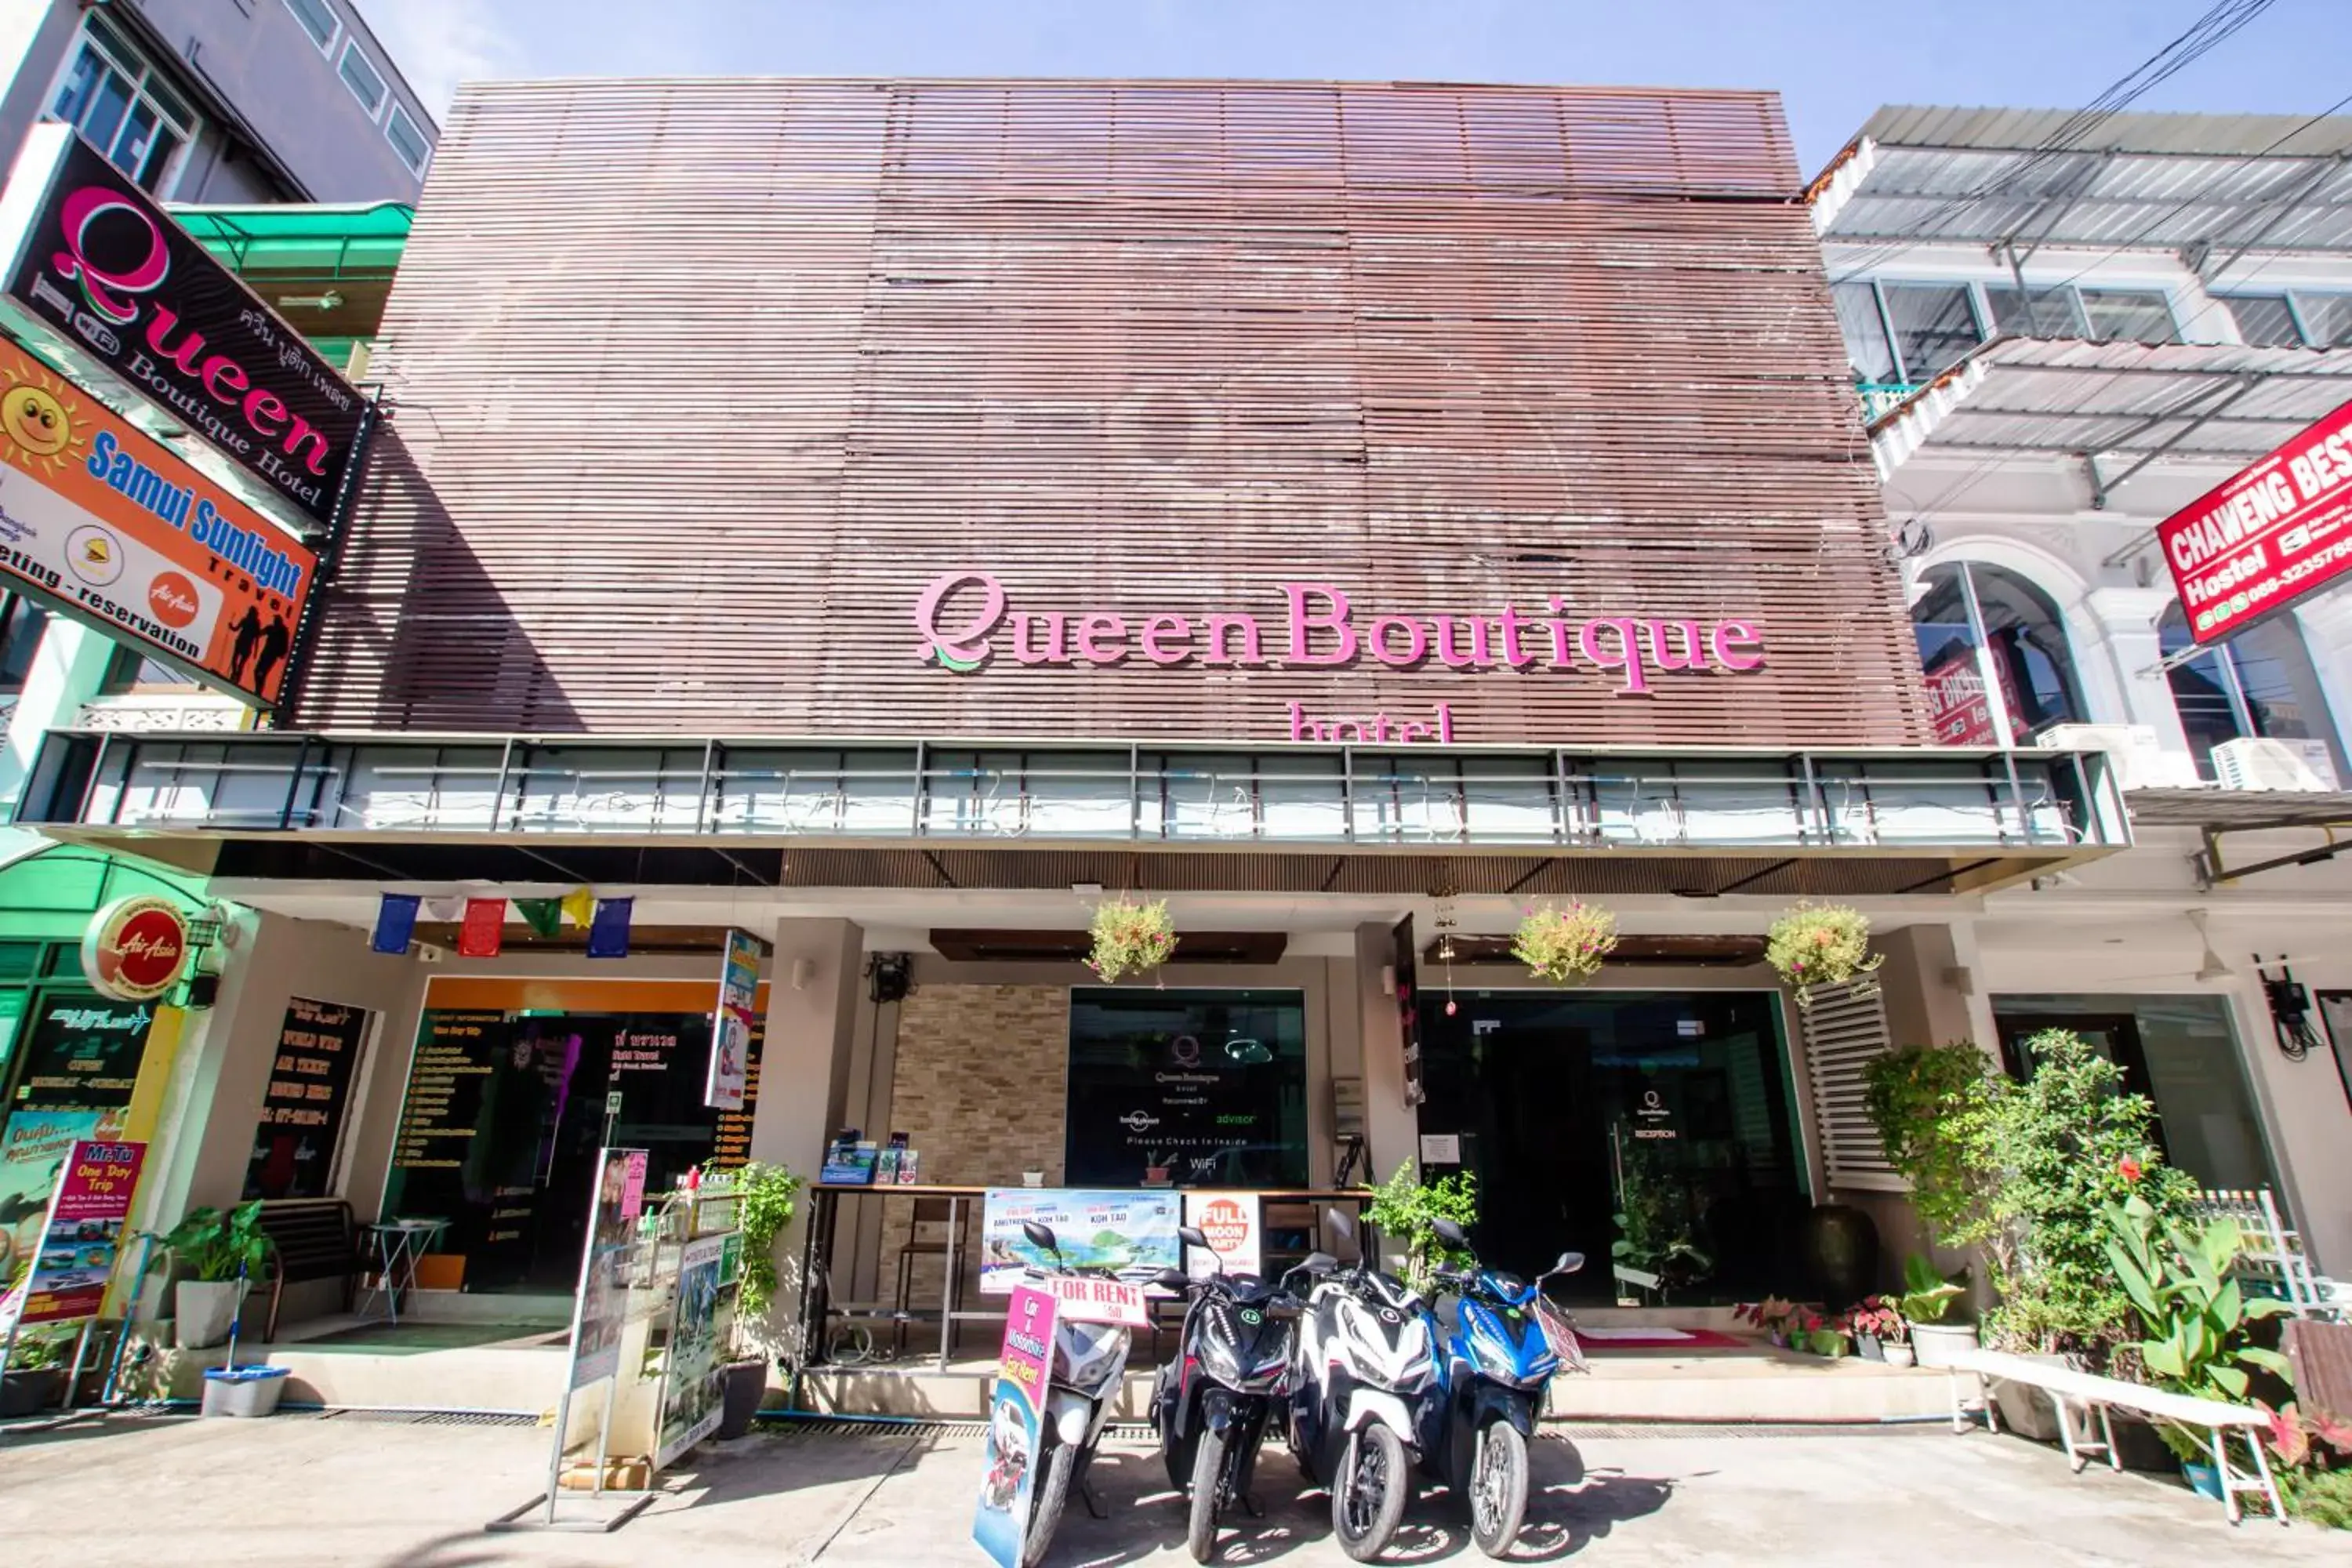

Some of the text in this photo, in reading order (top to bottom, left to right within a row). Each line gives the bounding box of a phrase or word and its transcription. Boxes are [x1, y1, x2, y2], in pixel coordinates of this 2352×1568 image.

[52, 186, 328, 476] Queen
[125, 350, 323, 507] Boutique Hotel
[87, 430, 303, 602] Samui Sunlight
[2170, 471, 2298, 572] CHAWENG
[209, 555, 292, 619] Travel
[2184, 543, 2268, 607] Hostel
[79, 586, 200, 658] reservation
[1287, 702, 1451, 743] hotel
[1216, 1113, 1255, 1124] advisor
[77, 1163, 132, 1180] One Day
[1189, 1158, 1216, 1171] WiFi
[88, 1178, 114, 1193] Trip
[1199, 1205, 1247, 1224] FULL
[1202, 1225, 1245, 1238] MOON
[1024, 1296, 1039, 1317] Car
[1052, 1279, 1138, 1307] FOR RENT
